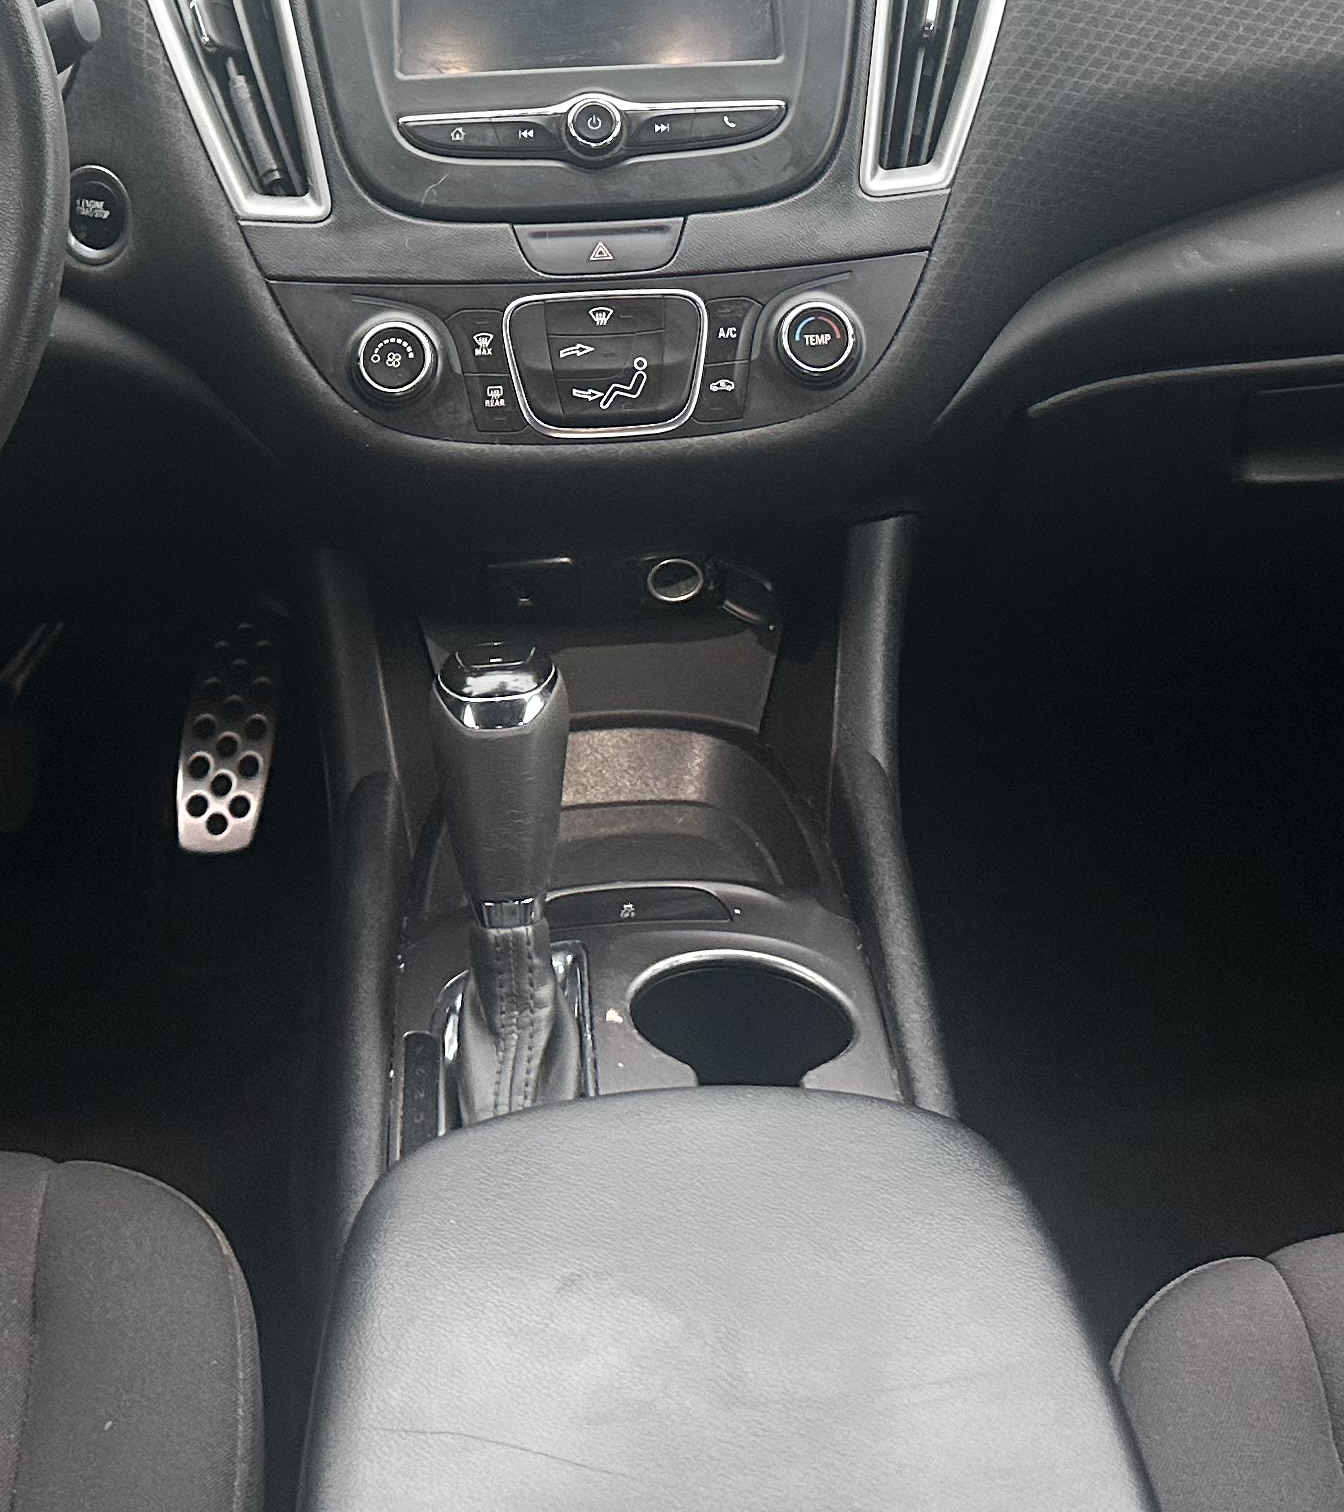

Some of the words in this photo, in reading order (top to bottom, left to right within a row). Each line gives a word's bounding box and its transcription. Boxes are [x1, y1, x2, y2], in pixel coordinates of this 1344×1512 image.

[718, 327, 737, 338] A/C
[804, 333, 832, 346] TEMP
[474, 347, 493, 356] MAX
[484, 398, 506, 408] REAR
